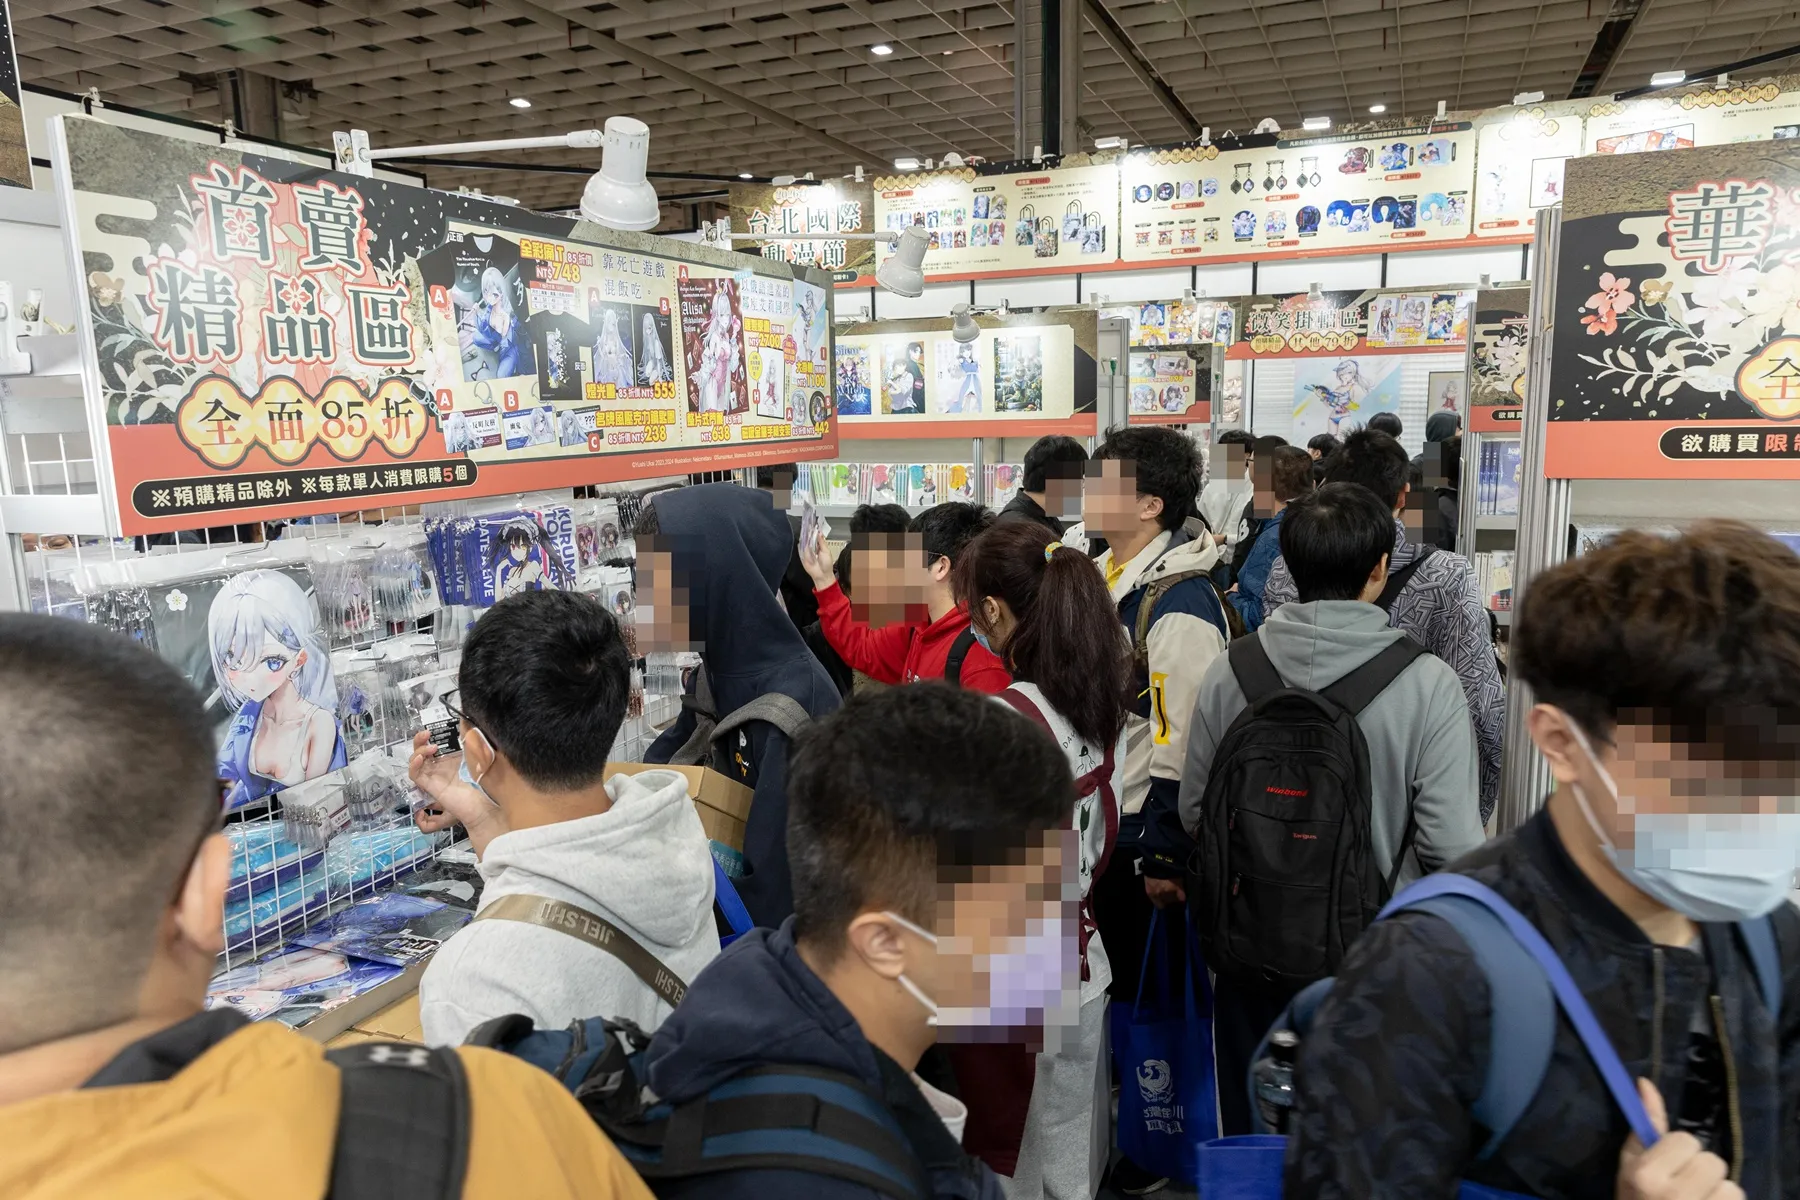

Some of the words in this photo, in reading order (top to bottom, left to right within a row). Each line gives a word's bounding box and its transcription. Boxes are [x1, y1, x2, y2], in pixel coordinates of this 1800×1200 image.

[193, 163, 364, 277] 首賣
[749, 202, 861, 234] 台北國際
[1672, 185, 1768, 267] 華
[602, 252, 666, 279] 靠死亡遊戲
[763, 241, 845, 267] 動漫節
[536, 263, 581, 283] NT$748
[434, 291, 445, 304] A
[681, 301, 703, 315] Alisa
[149, 259, 413, 366] 精品區
[440, 393, 450, 406] A
[508, 394, 516, 407] B
[701, 426, 731, 443] NT$638
[152, 479, 292, 508] ※預購精品除外
[301, 465, 468, 494] ※每款單人消費限購5個
[479, 519, 490, 552] DATE
[558, 509, 576, 582] KURUMI
[1292, 832, 1317, 840] Targus
